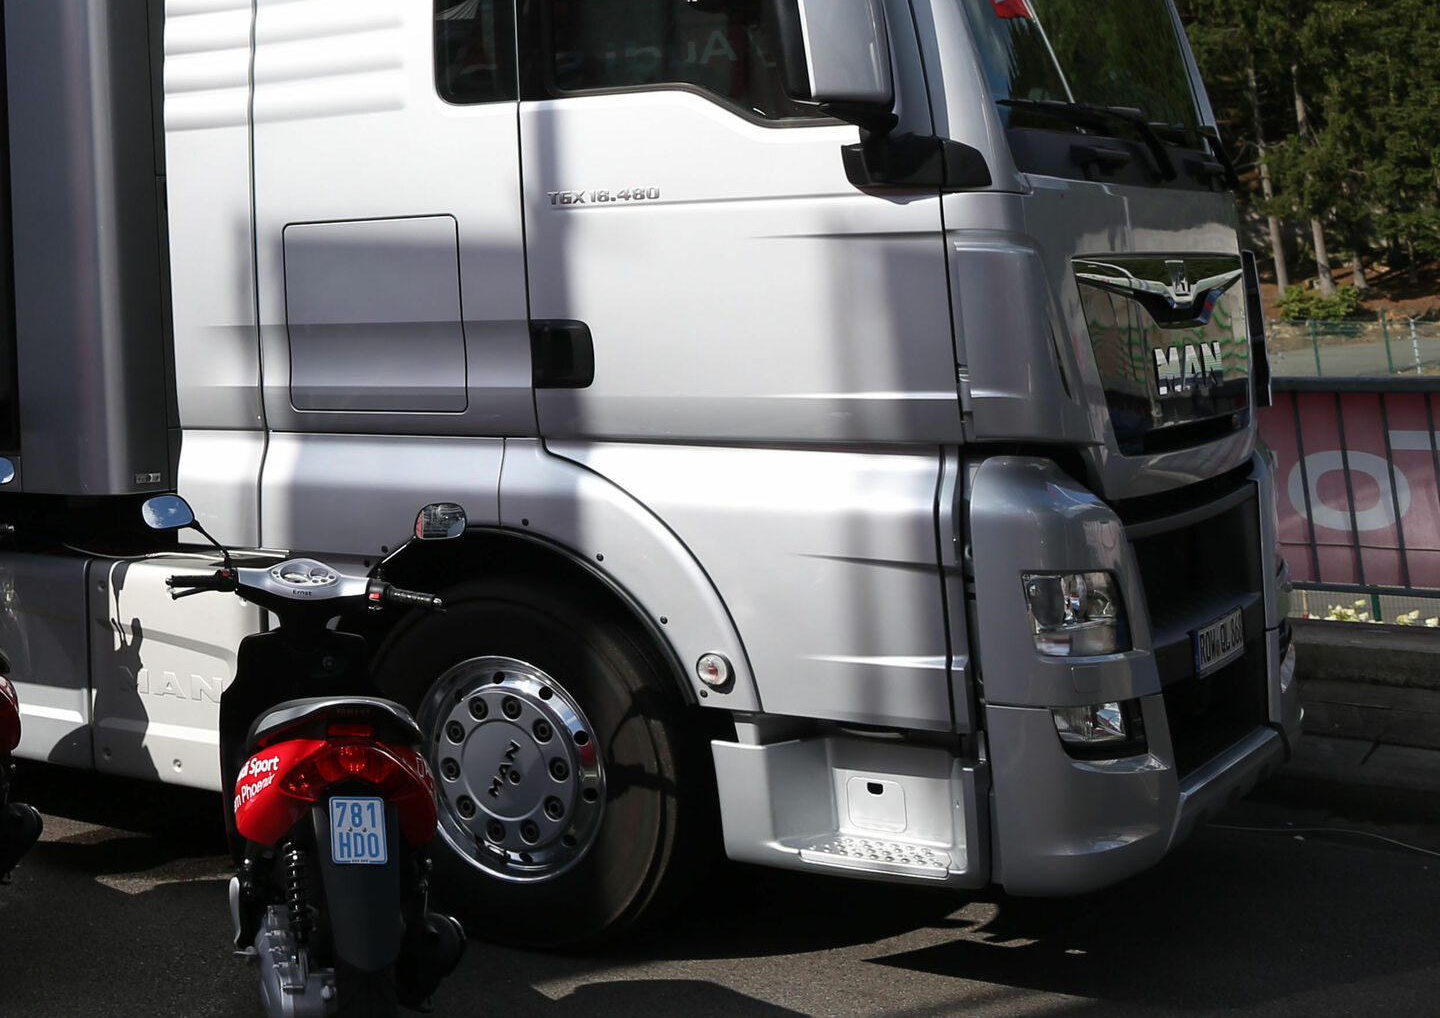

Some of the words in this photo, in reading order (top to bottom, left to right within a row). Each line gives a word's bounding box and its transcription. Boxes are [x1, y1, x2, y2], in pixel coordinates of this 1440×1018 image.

[547, 190, 586, 205] TGX
[1153, 341, 1224, 395] MAN
[292, 588, 313, 597] Ernst
[248, 755, 280, 778] Sport
[488, 738, 521, 798] MAN
[241, 772, 276, 803] Phoenix
[335, 802, 377, 829] 781
